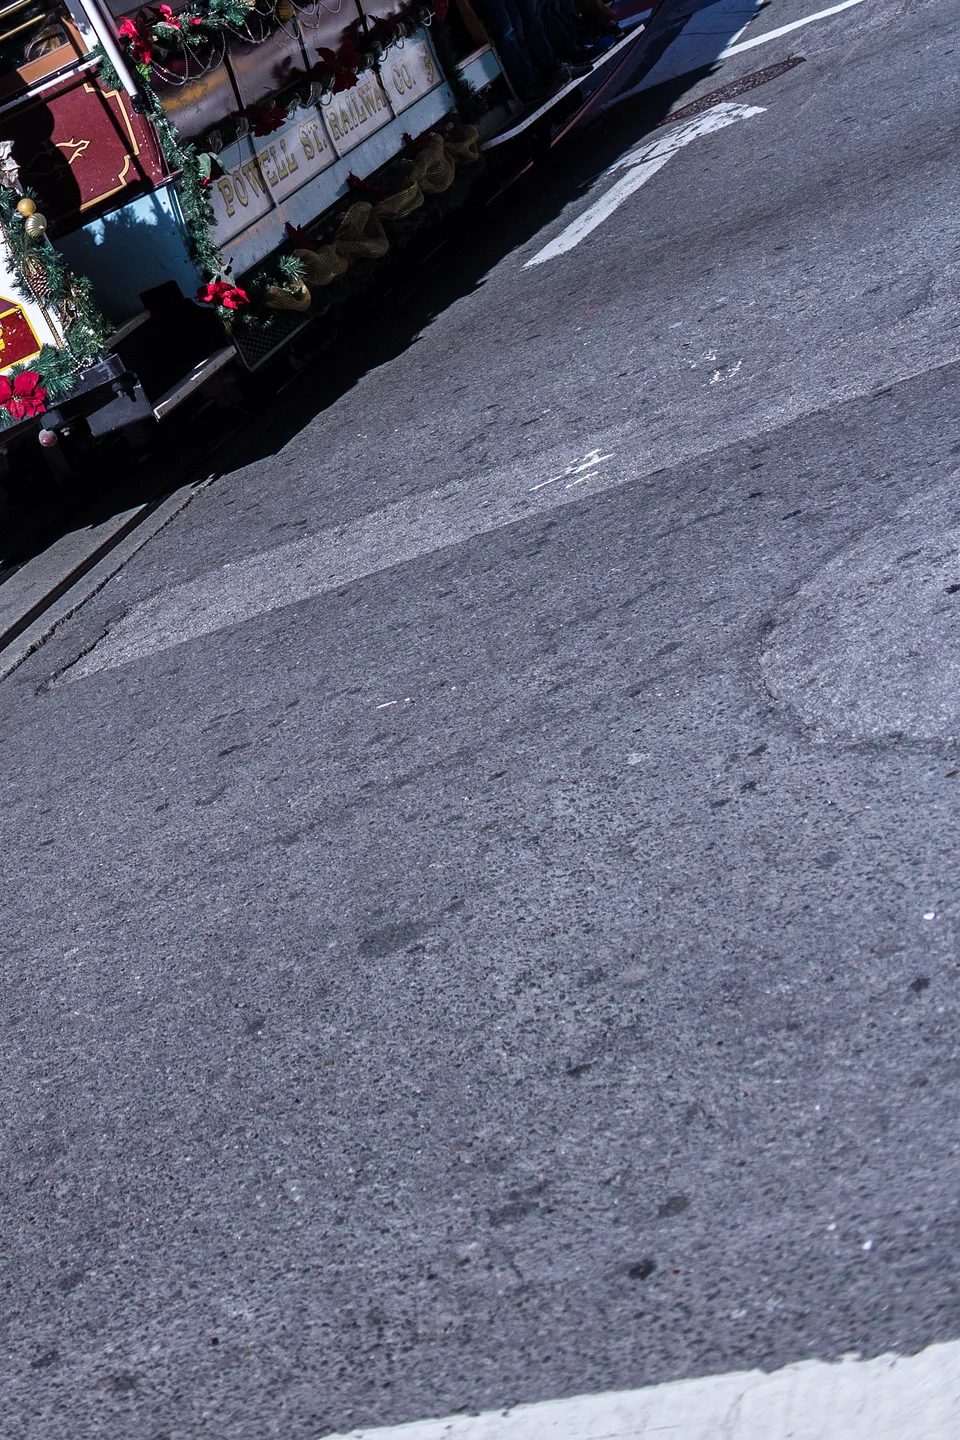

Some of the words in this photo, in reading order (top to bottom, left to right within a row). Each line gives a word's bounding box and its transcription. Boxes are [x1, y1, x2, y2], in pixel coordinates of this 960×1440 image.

[217, 139, 299, 218] POWELL
[298, 116, 328, 161] ST.
[326, 78, 388, 141] RAILWA
[391, 59, 417, 96] CO.
